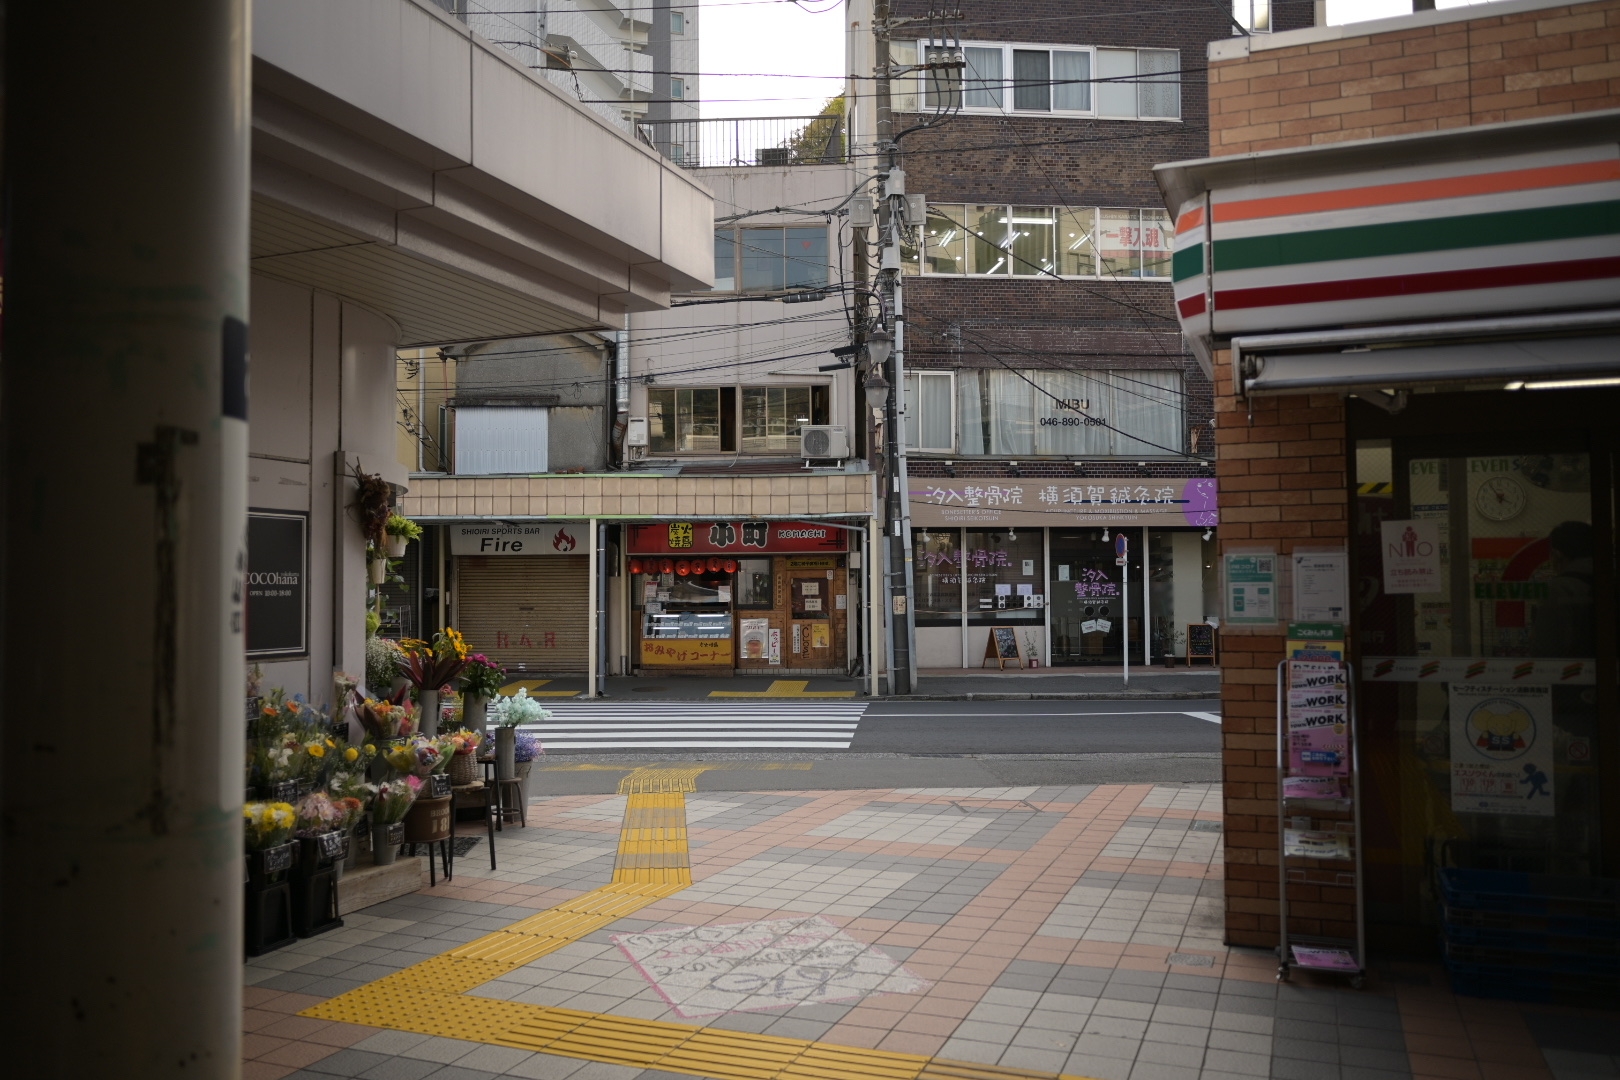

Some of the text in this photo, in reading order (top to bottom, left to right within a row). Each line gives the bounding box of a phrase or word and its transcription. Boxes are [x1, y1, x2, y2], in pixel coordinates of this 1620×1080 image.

[1106, 227, 1159, 247] 一撃入魂
[1055, 399, 1090, 410] MIBU
[1040, 417, 1106, 427] 046-890-0501
[926, 486, 1023, 506] 汐入整骨院
[1039, 486, 1174, 506] 横須賀鍼灸院
[461, 528, 490, 536] SHIOIRI
[708, 522, 770, 548] 小町
[778, 529, 826, 539] KOMACHI
[480, 538, 523, 552] Fire
[1082, 568, 1109, 582] 汐入
[1390, 568, 1434, 576] 立ち読み禁止
[1306, 674, 1345, 686] WORK
[1306, 694, 1346, 706] WORK
[1306, 714, 1346, 726] WORK
